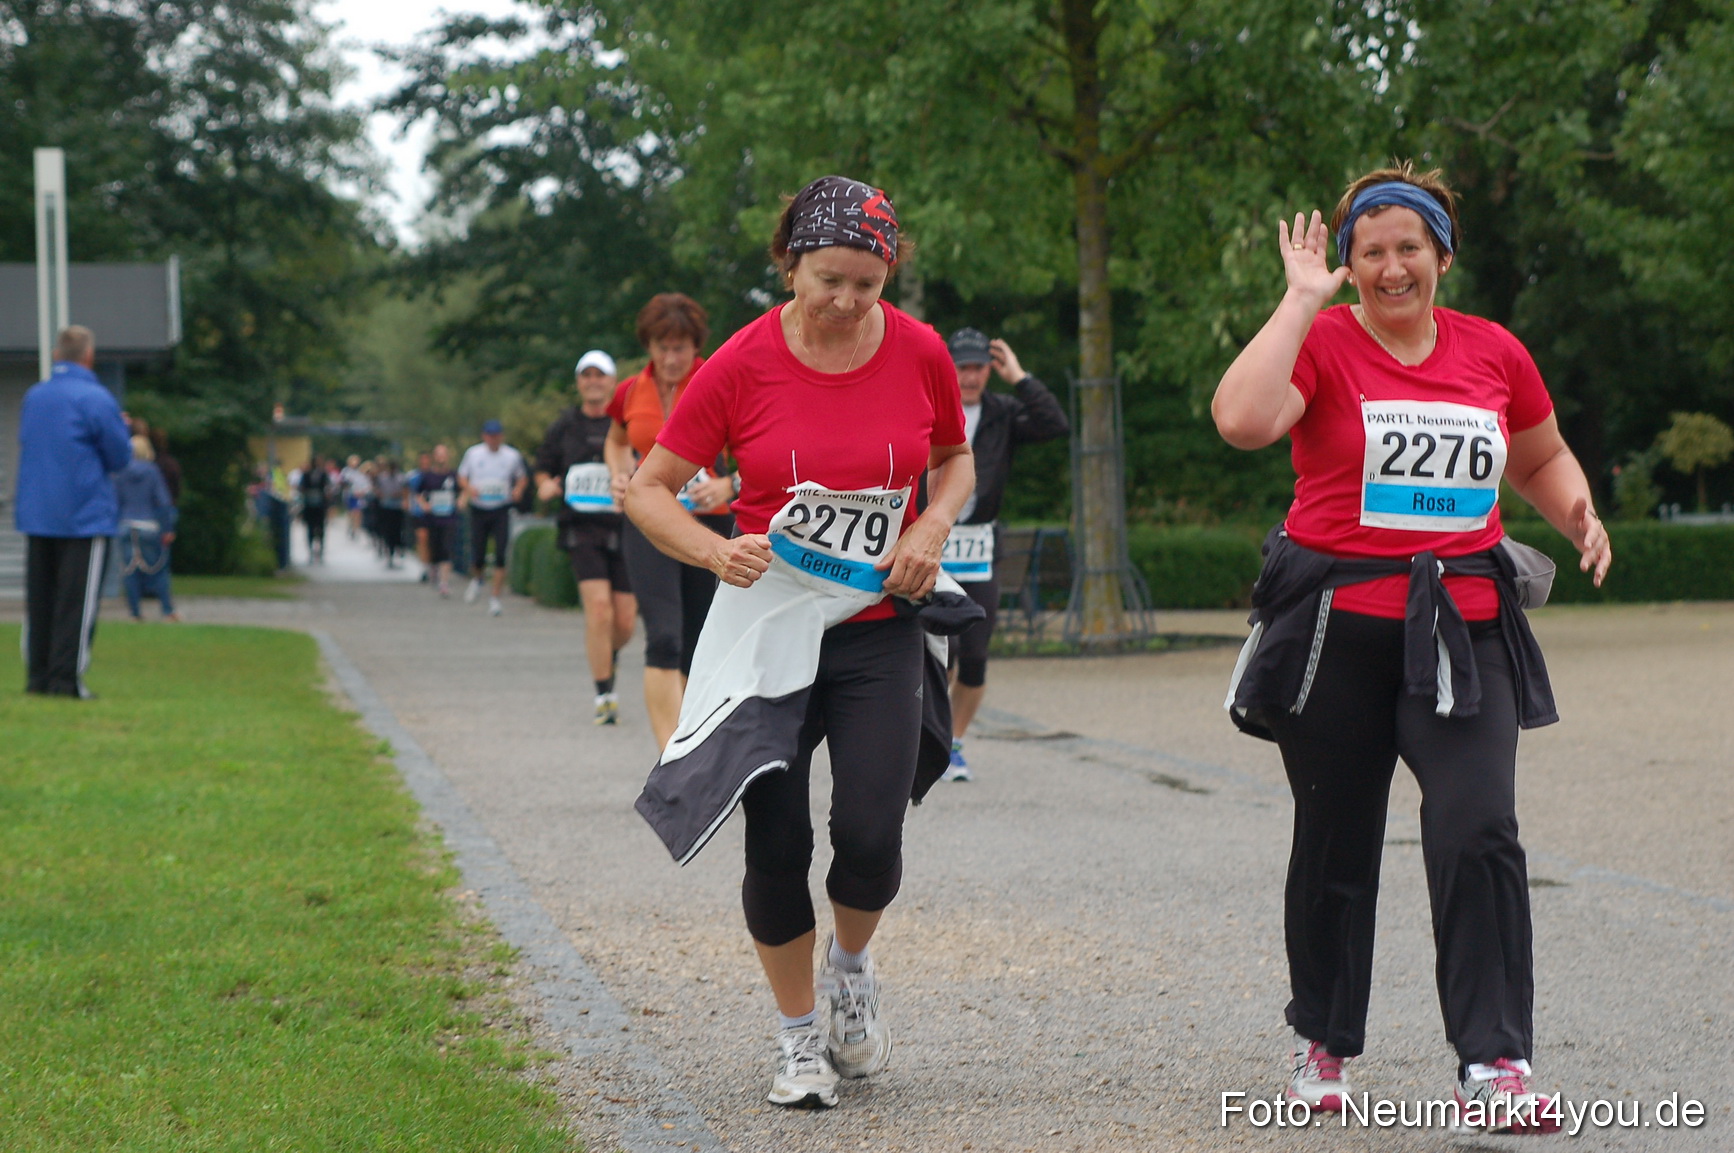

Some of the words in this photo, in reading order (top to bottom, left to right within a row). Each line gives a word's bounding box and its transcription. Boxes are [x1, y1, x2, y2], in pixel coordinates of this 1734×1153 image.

[1367, 413, 1414, 424] PARTL
[1417, 415, 1480, 428] Neumarkt
[1380, 431, 1493, 481] 2276
[1412, 492, 1456, 512] Rosa
[782, 503, 890, 556] 2279
[942, 538, 985, 558] 2171
[800, 552, 852, 582] Gerda
